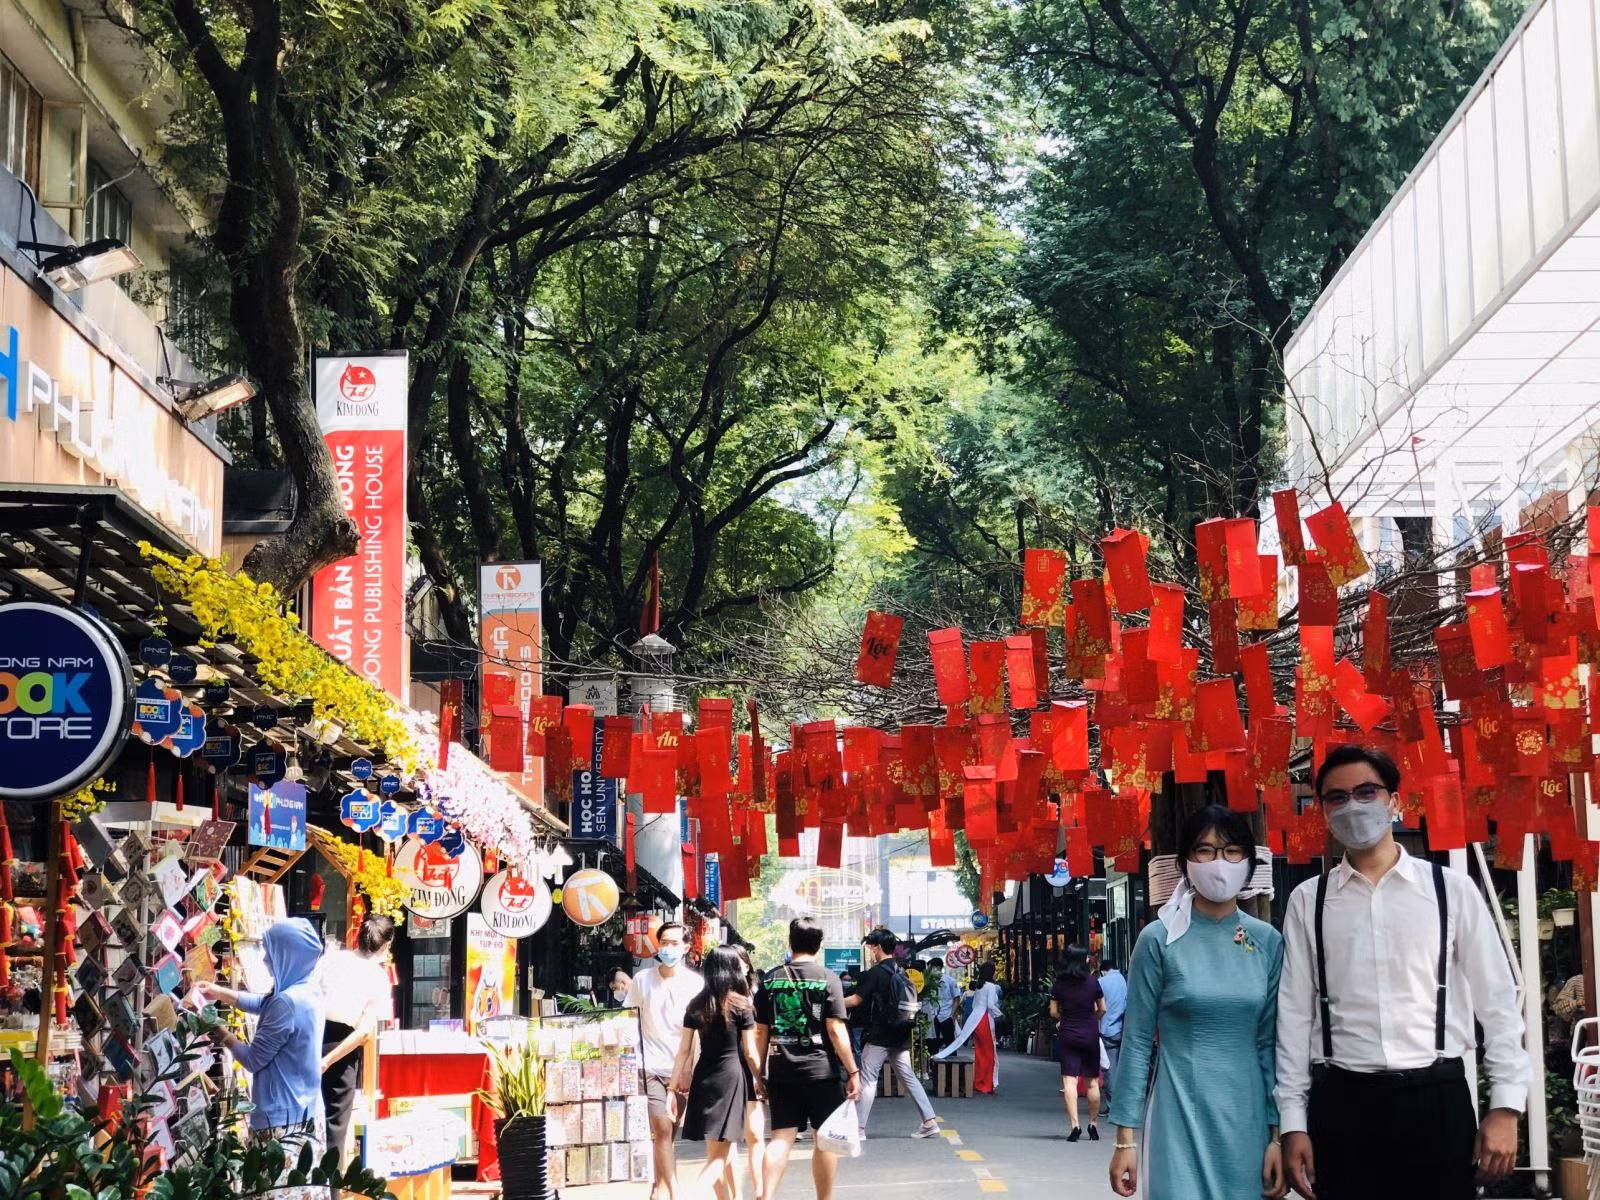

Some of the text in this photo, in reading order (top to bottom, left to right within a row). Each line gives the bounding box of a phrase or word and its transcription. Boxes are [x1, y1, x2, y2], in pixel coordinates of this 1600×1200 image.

[336, 400, 353, 417] KIM
[365, 445, 383, 509] HOUSE
[364, 516, 382, 622] PUBLISHING
[328, 565, 352, 610] BẢN
[327, 616, 352, 666] UẤT
[47, 657, 94, 668] NAM
[139, 704, 166, 714] BOOK
[256, 713, 275, 721] PNC
[657, 731, 679, 748] An
[580, 770, 595, 833] HỌC HO
[596, 808, 607, 832] SEN
[492, 911, 510, 929] KIM
[920, 917, 973, 930] STARB
